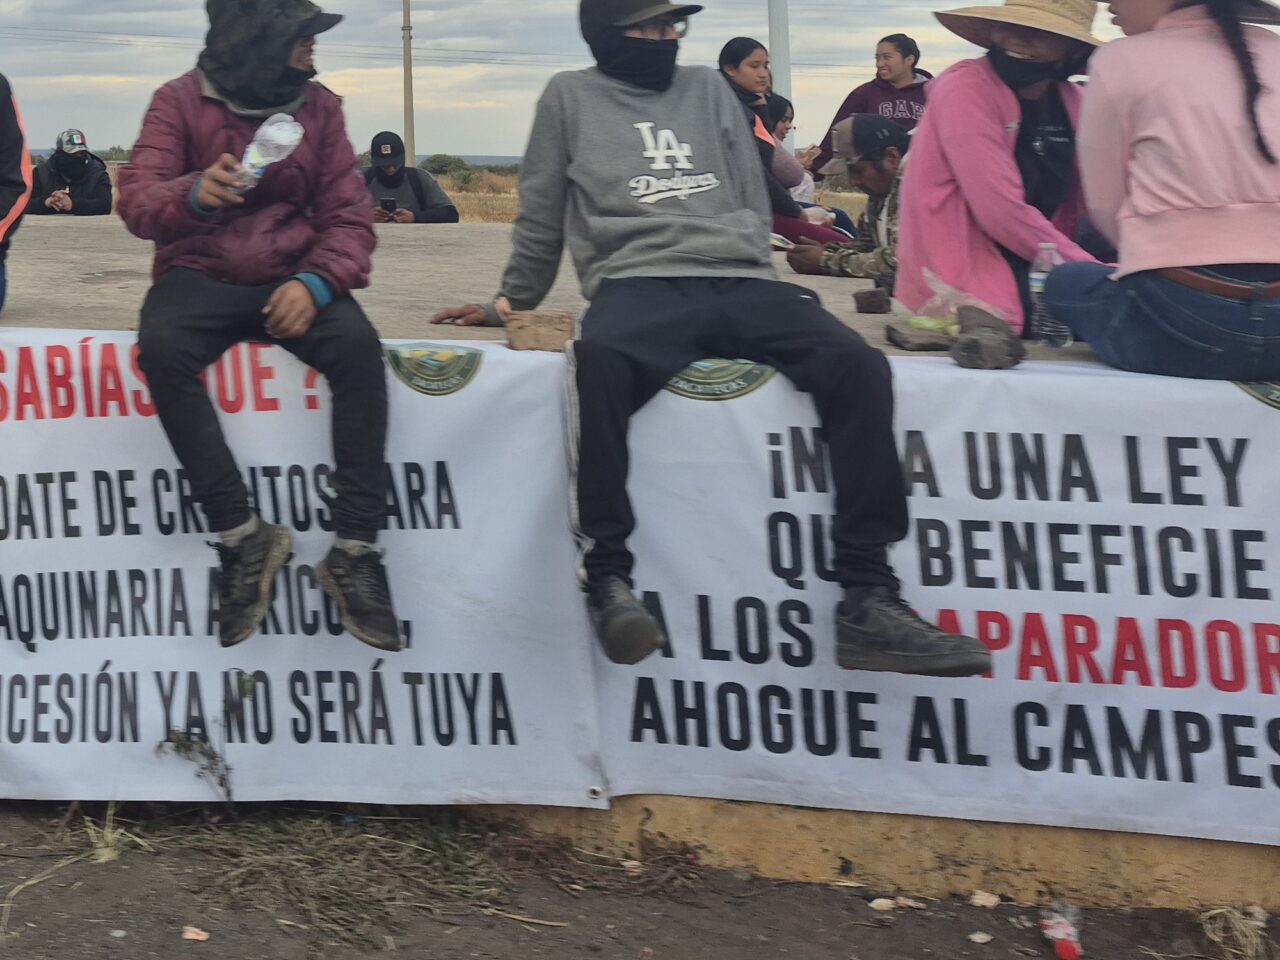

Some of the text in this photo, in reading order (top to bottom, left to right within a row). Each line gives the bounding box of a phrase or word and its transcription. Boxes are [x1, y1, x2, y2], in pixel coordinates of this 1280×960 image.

[633, 121, 694, 170] LA
[878, 99, 926, 121] GAP
[628, 171, 721, 203] Dodgers
[92, 468, 143, 537] DE
[384, 460, 462, 530] ARA
[766, 425, 1250, 508] ¡N A UNA LEY
[767, 510, 1274, 601] QU BENEFICIE
[696, 594, 814, 668] LOS
[153, 670, 210, 744] YA
[223, 669, 273, 745] NO
[289, 657, 396, 746] SERÁ
[402, 671, 519, 746] TUYA
[631, 676, 882, 760] AHOGUE
[907, 695, 990, 767] AL
